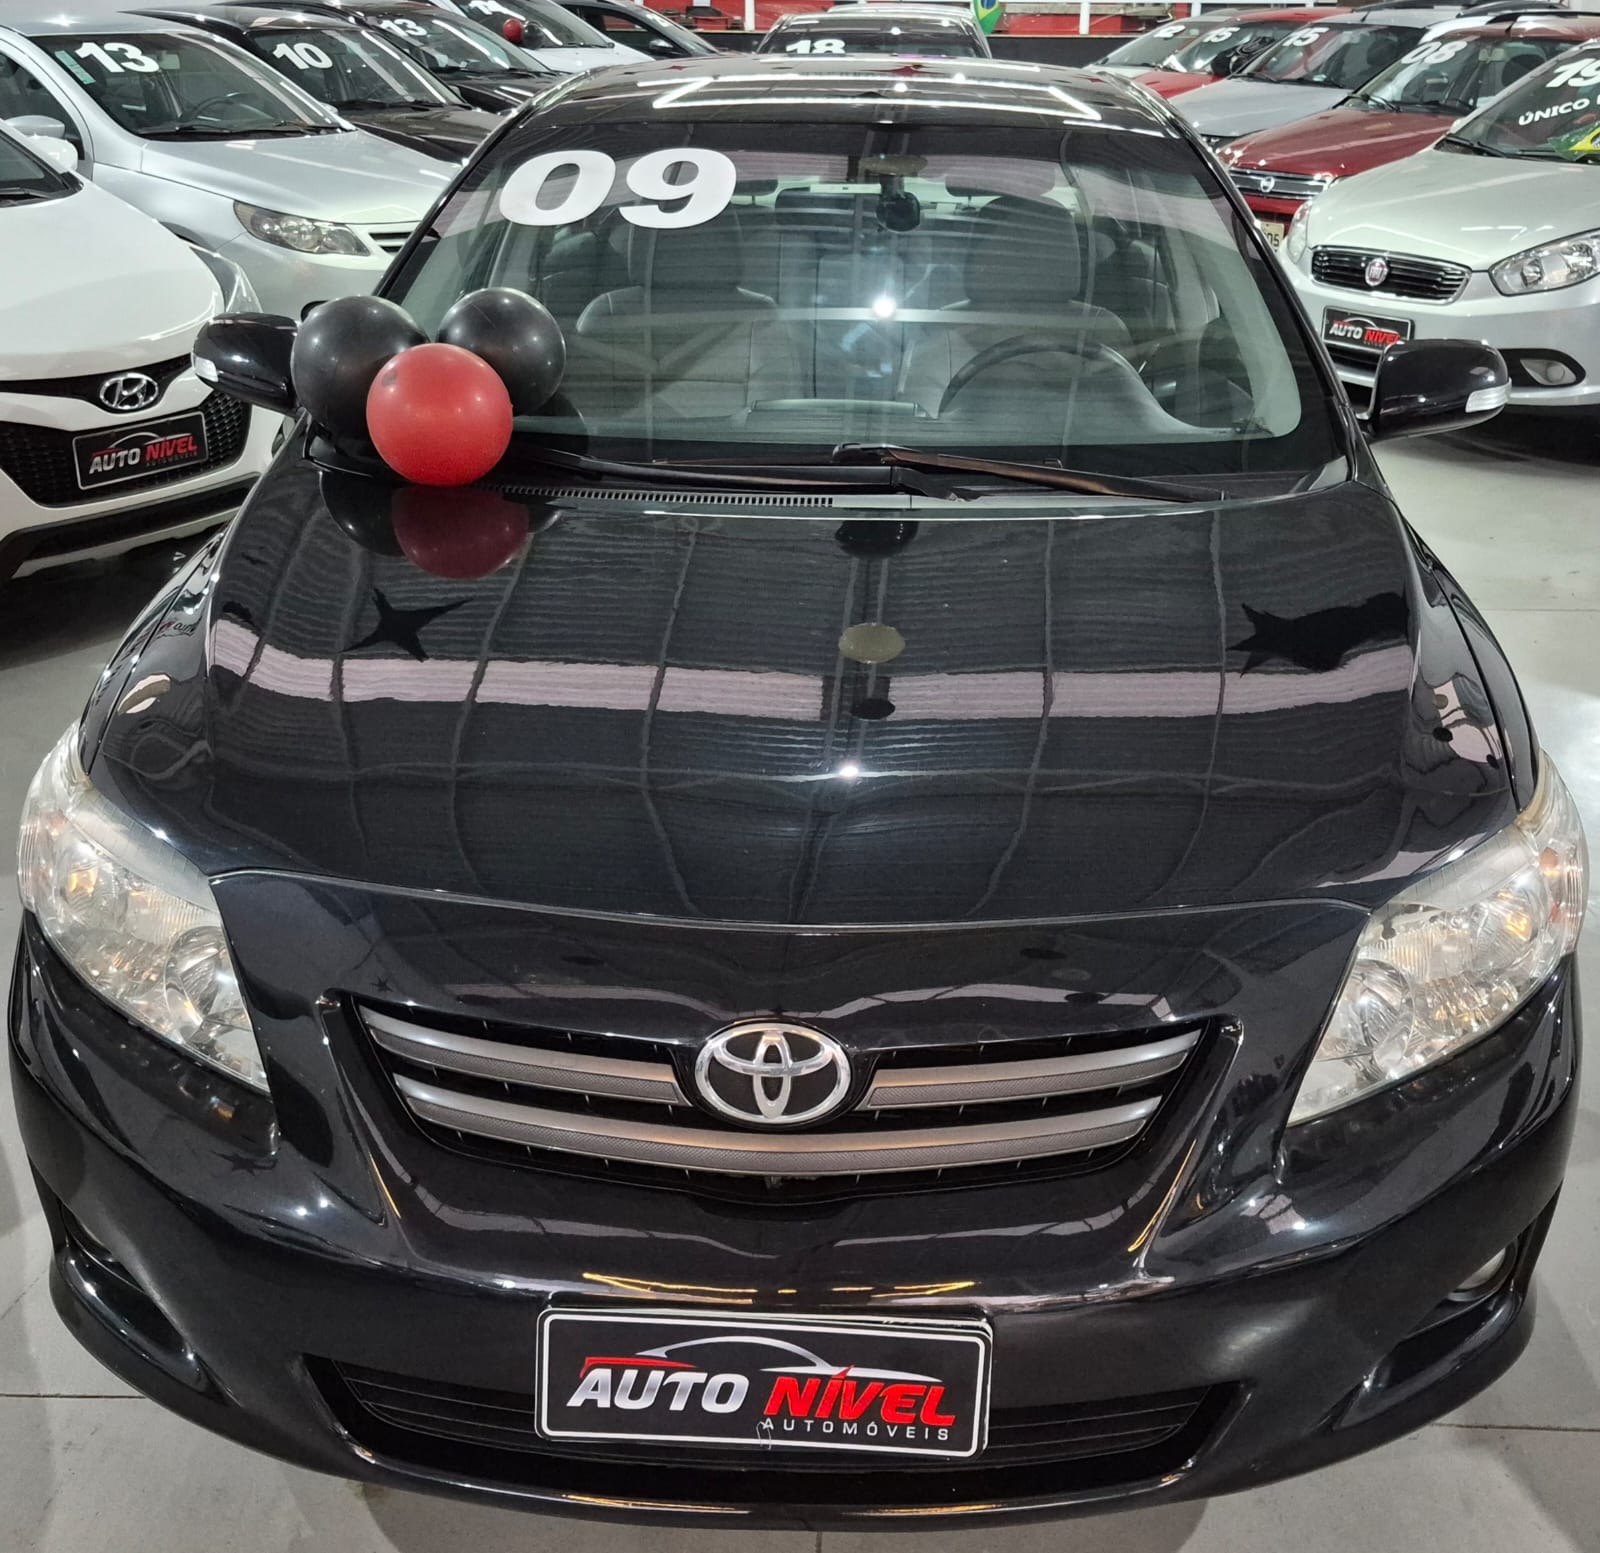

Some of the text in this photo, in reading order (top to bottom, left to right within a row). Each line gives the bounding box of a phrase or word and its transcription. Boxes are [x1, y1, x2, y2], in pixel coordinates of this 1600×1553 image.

[380, 18, 428, 37] 13
[1282, 26, 1331, 47] 15
[74, 42, 160, 73] 13
[272, 42, 334, 70] 10
[785, 38, 846, 54] 18
[1401, 40, 1468, 64] 08
[1545, 58, 1600, 87] 19
[499, 147, 737, 229] 09
[1329, 323, 1363, 339] AUTO
[89, 447, 141, 475] AUTO
[566, 1364, 957, 1427] AUTO NÍVEL
[762, 1417, 950, 1442] AUTOMÓVEIS
